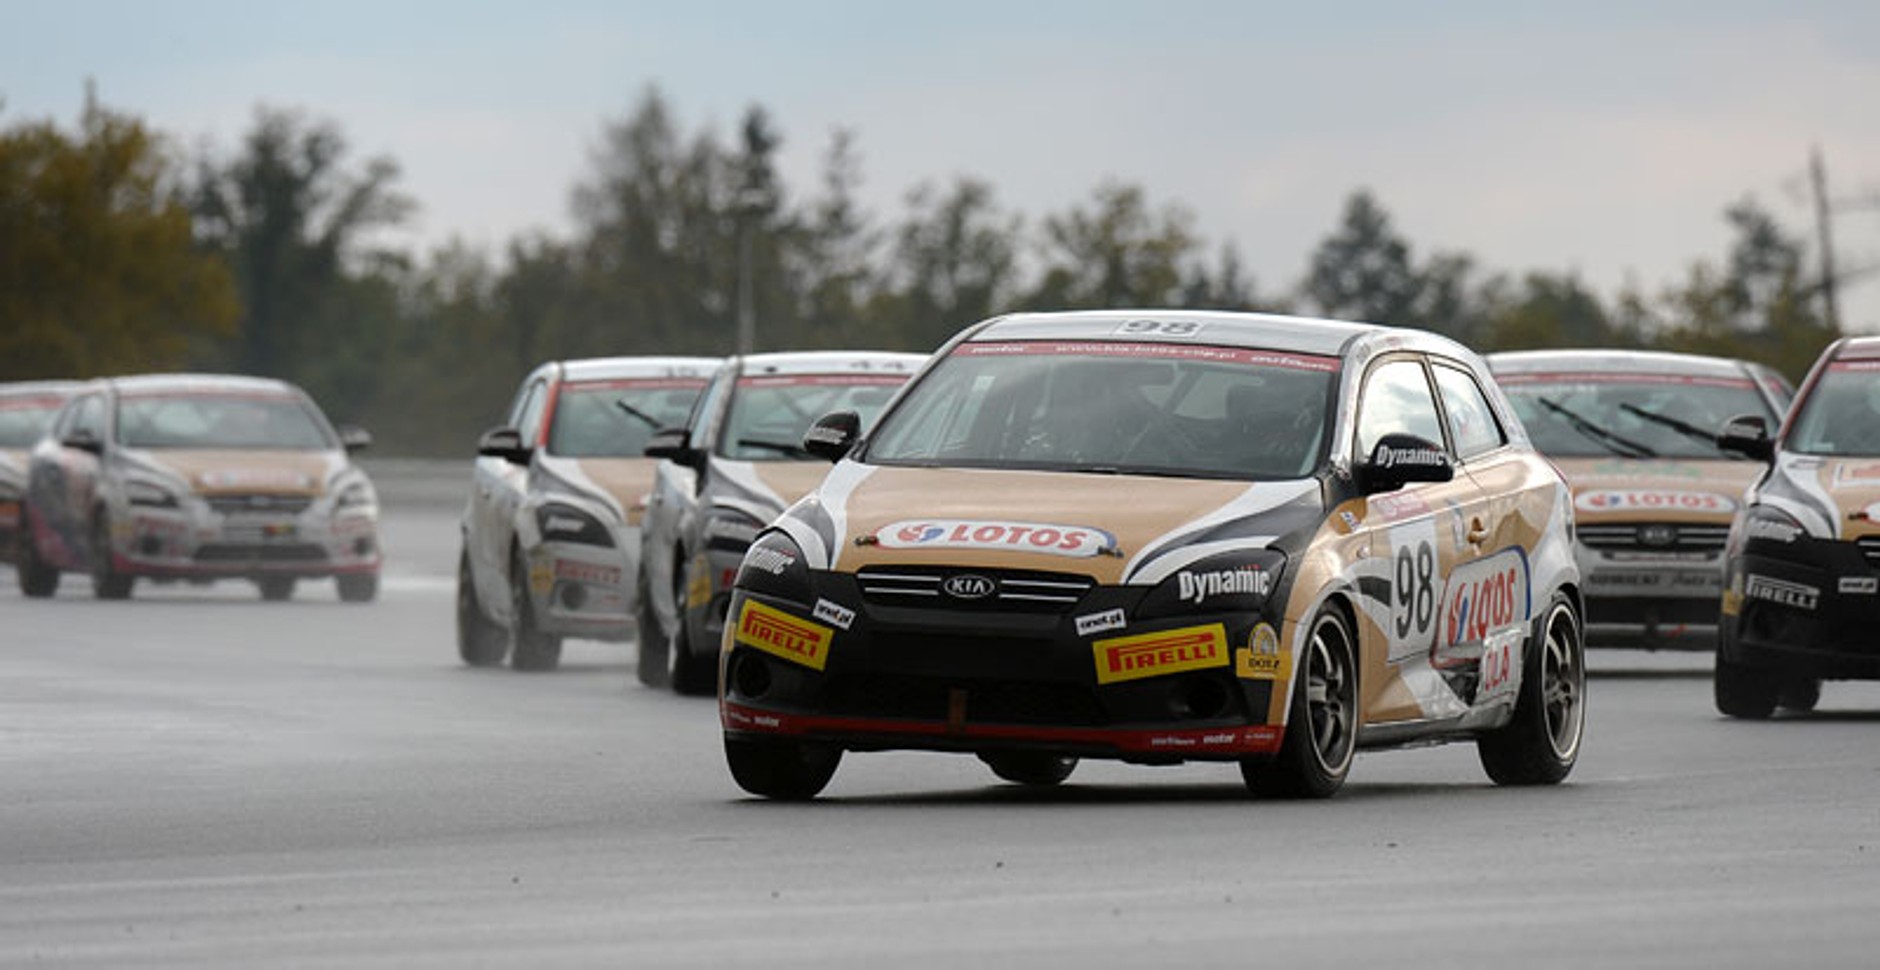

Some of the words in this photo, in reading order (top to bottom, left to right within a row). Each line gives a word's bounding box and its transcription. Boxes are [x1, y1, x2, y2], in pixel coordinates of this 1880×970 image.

[1124, 319, 1199, 334] 98
[1376, 446, 1446, 468] Dynamic
[1627, 494, 1718, 508] LOTOS
[949, 525, 1087, 549] LOTOS
[951, 579, 985, 593] KIA
[1177, 567, 1270, 603] Dynamic
[1396, 540, 1433, 639] 98
[1746, 573, 1820, 610] PIRELLI
[742, 608, 822, 658] PIRELLI
[1080, 612, 1123, 630] onet.pl
[1106, 632, 1217, 673] PIRELLI
